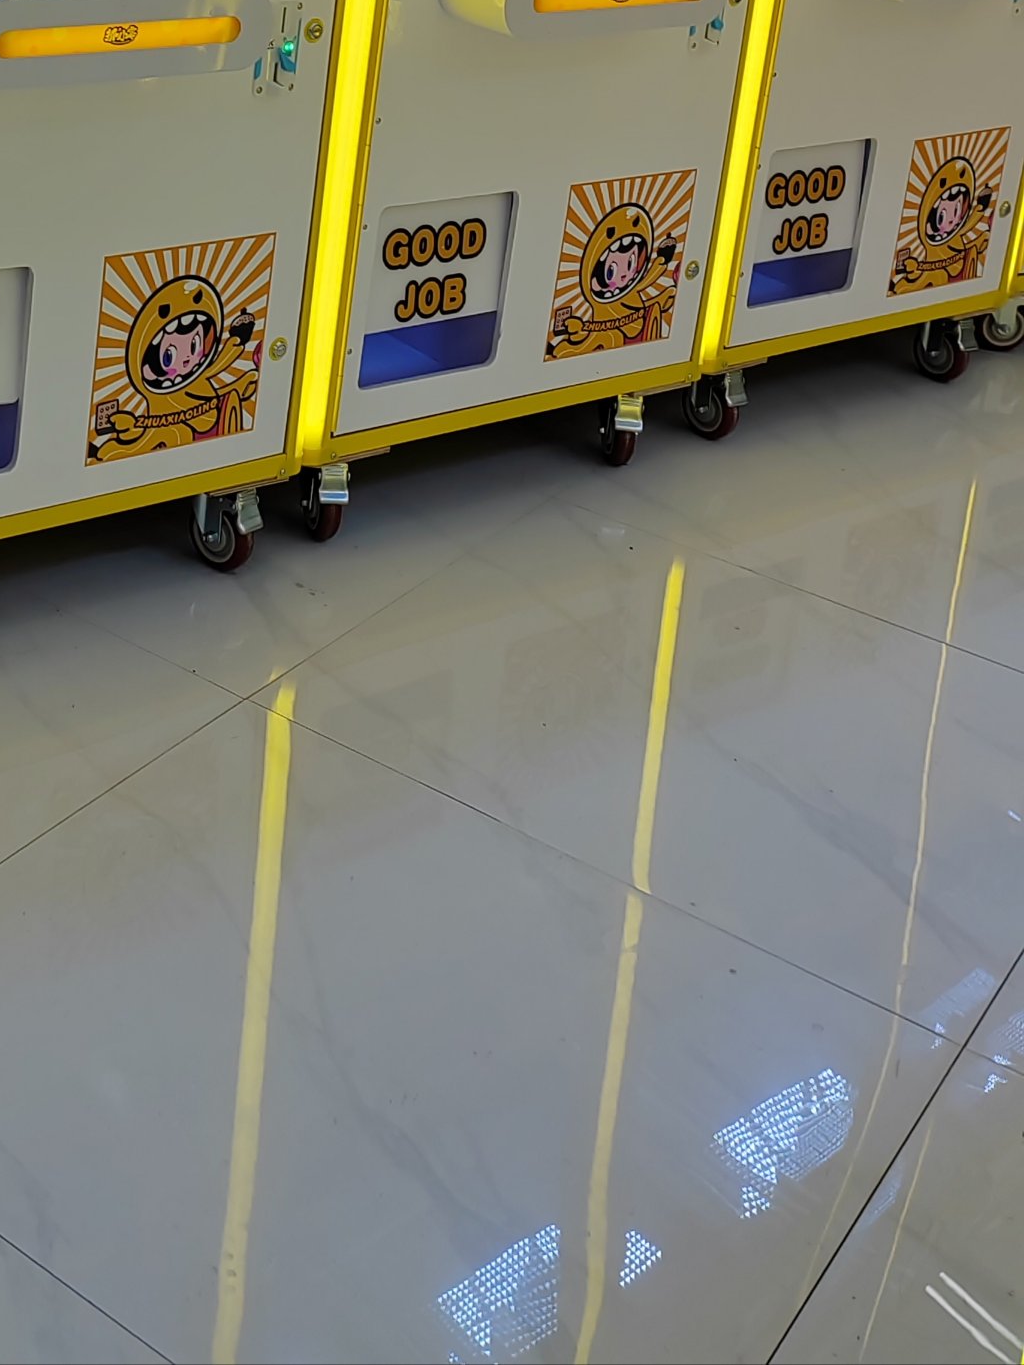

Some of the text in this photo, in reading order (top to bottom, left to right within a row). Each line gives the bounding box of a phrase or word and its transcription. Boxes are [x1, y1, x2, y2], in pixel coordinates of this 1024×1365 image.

[765, 165, 846, 209] GOOD
[383, 218, 486, 270] GOOD
[772, 213, 829, 255] JOB
[394, 273, 466, 322] JOB
[135, 400, 218, 428] ZHUAXIAOLING
